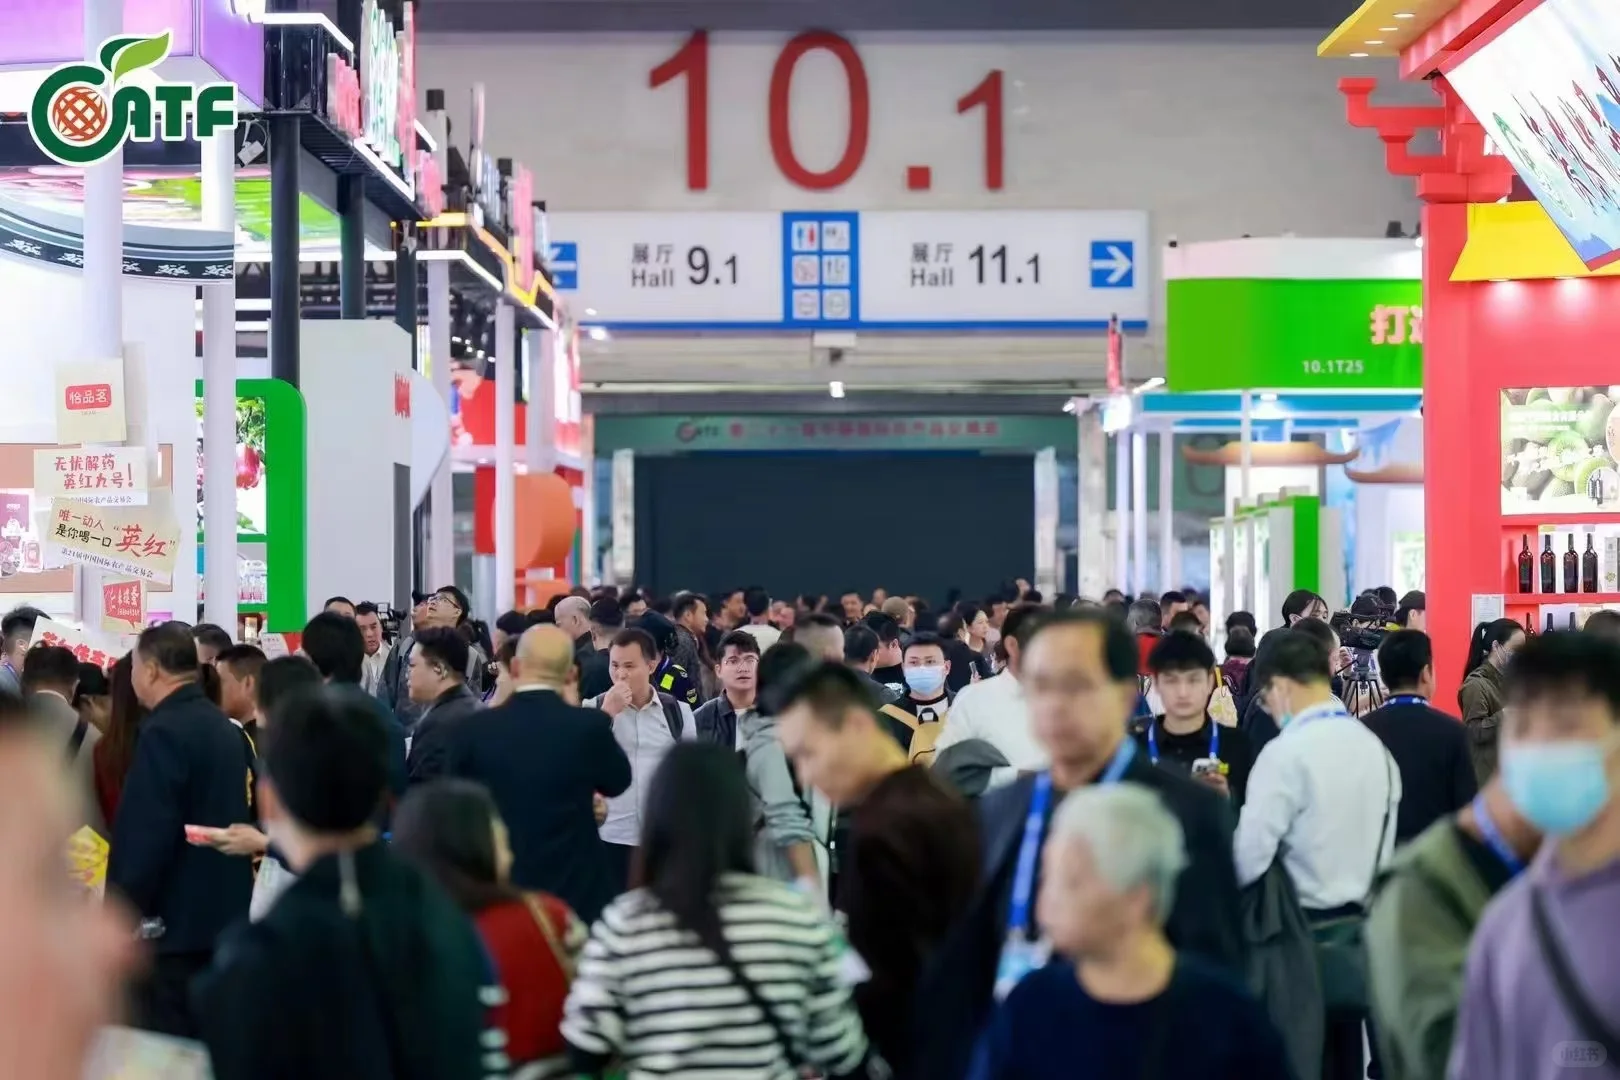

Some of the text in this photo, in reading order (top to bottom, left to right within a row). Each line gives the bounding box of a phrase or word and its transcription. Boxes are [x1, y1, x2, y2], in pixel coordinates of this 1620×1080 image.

[647, 29, 1005, 190] 10.1
[632, 242, 674, 264] 展厅
[912, 242, 953, 263] 展厅
[631, 245, 737, 287] Hall 9.1
[911, 244, 1040, 287] Hall 11.1
[1303, 359, 1364, 374] 10.1T25
[54, 453, 115, 471] 无忧解药
[58, 509, 104, 531] 唯一动人
